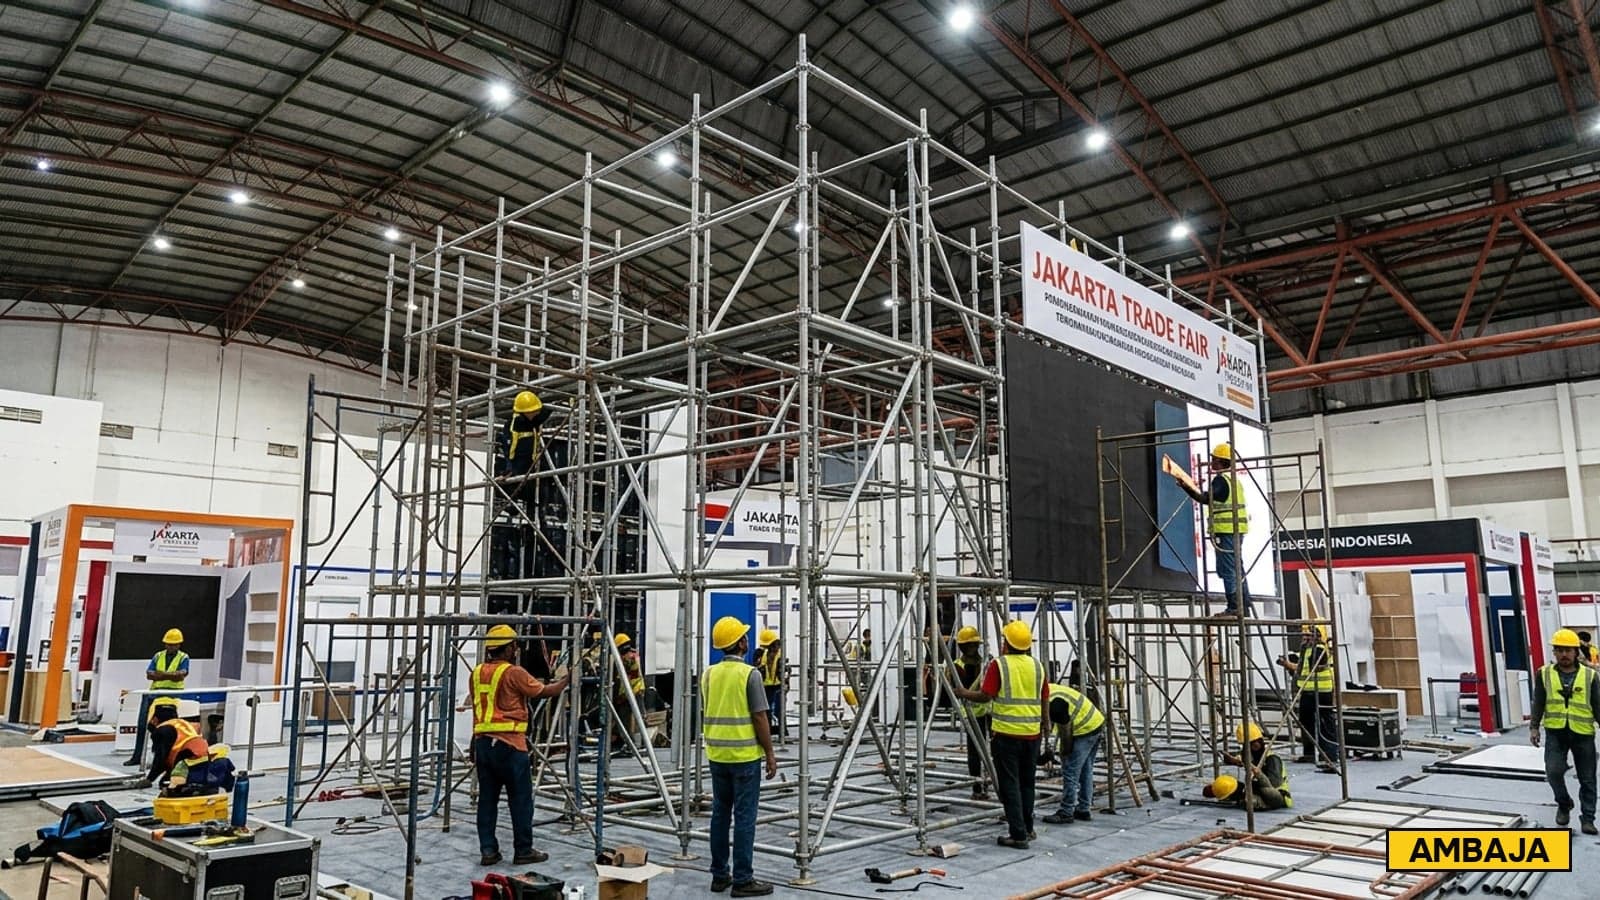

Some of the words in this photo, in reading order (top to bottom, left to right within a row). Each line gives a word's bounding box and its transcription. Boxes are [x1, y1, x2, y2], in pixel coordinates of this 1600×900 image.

[1033, 251, 1119, 317] JAKARTA
[1122, 294, 1174, 343] TRADE
[1178, 322, 1210, 360] FAIR
[1216, 347, 1253, 381] JAKARTA
[150, 528, 200, 542] JAKARTA
[1331, 533, 1413, 548] INDONESIA
